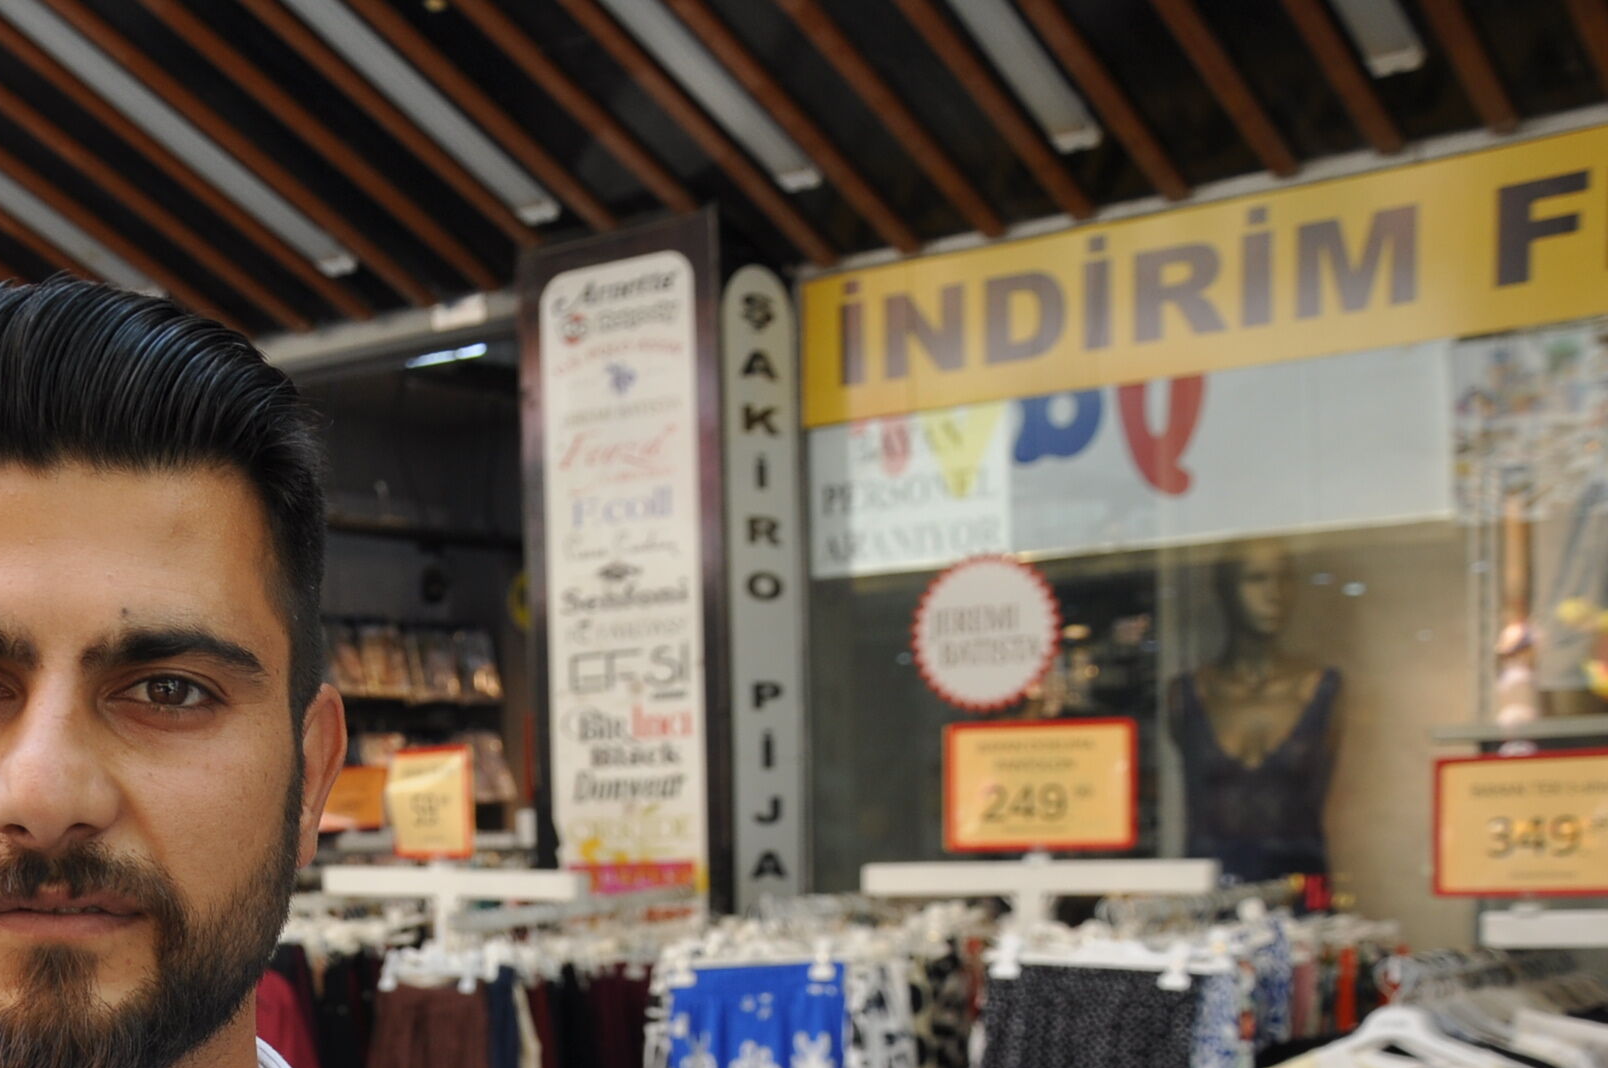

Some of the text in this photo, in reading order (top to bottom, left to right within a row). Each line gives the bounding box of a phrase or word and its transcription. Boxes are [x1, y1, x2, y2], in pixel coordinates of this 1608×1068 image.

[839, 168, 1608, 387] İNDİRİM F
[740, 293, 783, 602] ŞAKİRO
[981, 781, 1069, 826] 249
[1486, 813, 1584, 860] 349
